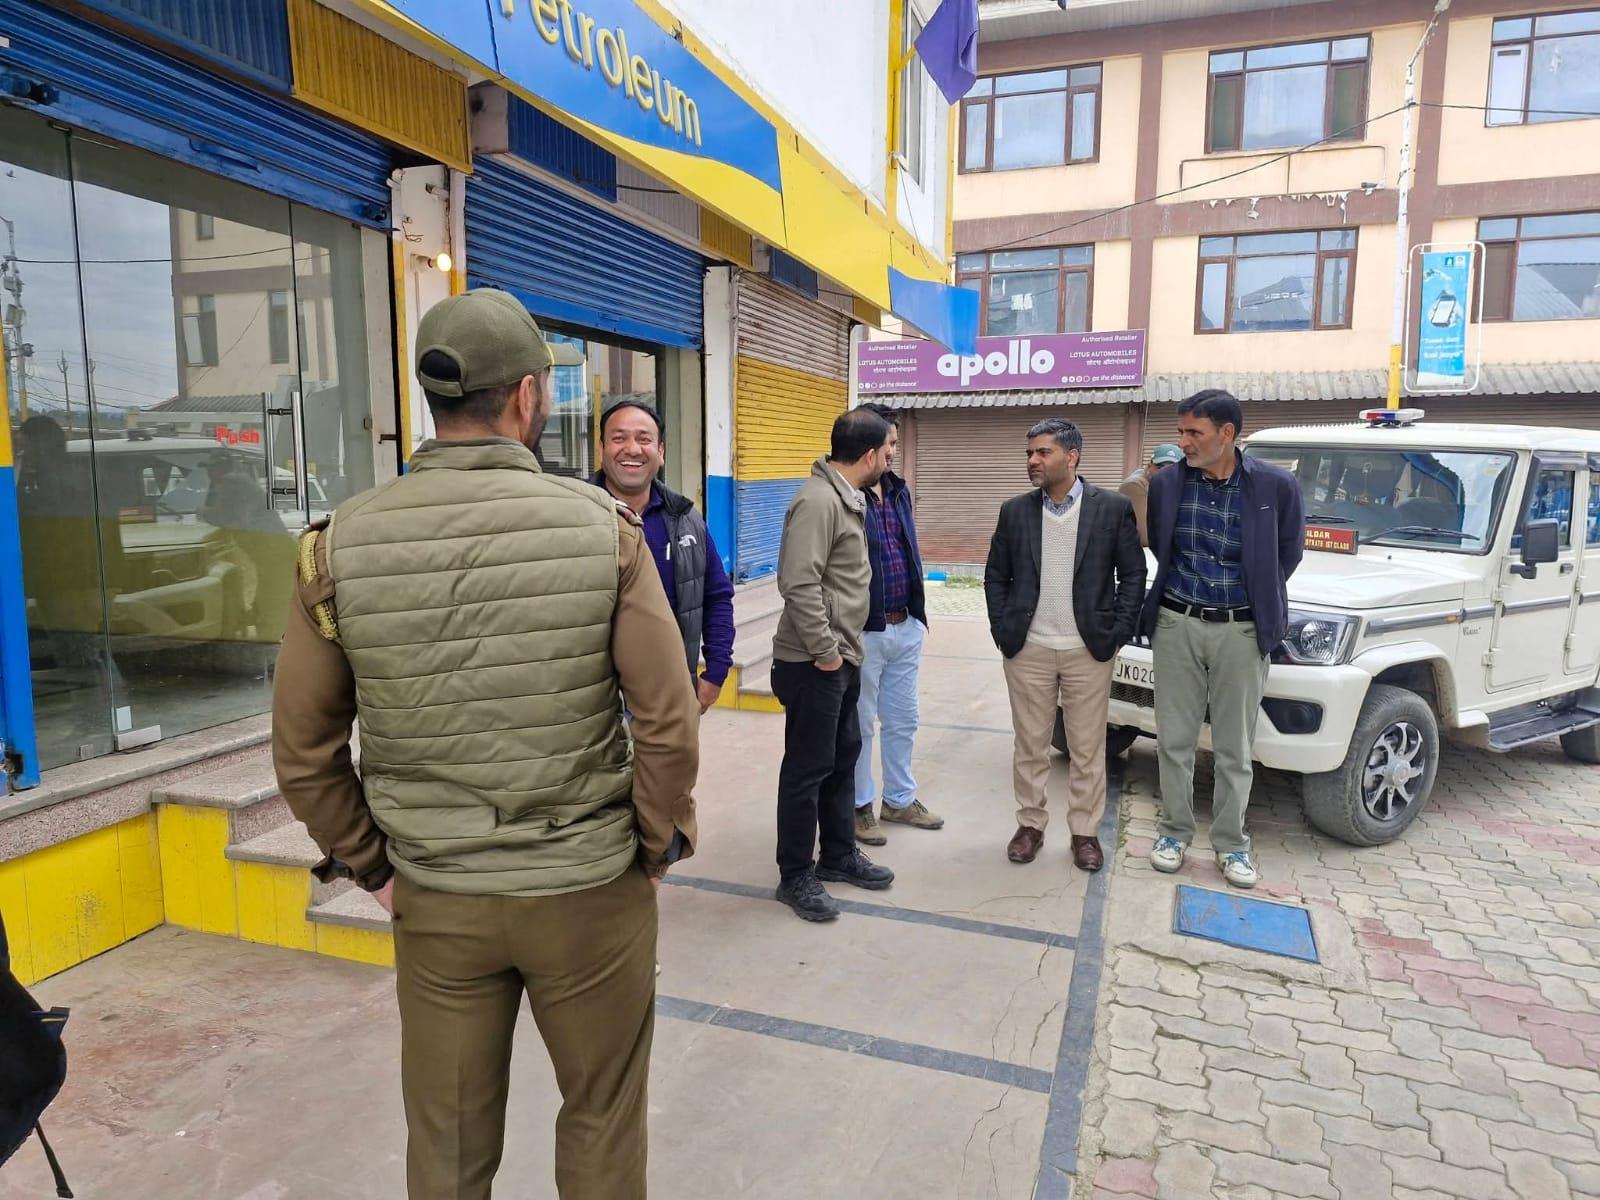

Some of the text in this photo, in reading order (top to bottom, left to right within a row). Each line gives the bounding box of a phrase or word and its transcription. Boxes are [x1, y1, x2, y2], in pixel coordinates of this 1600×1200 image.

[501, 0, 702, 148] etroleum
[937, 339, 1055, 386] apollo
[215, 424, 261, 446] Push
